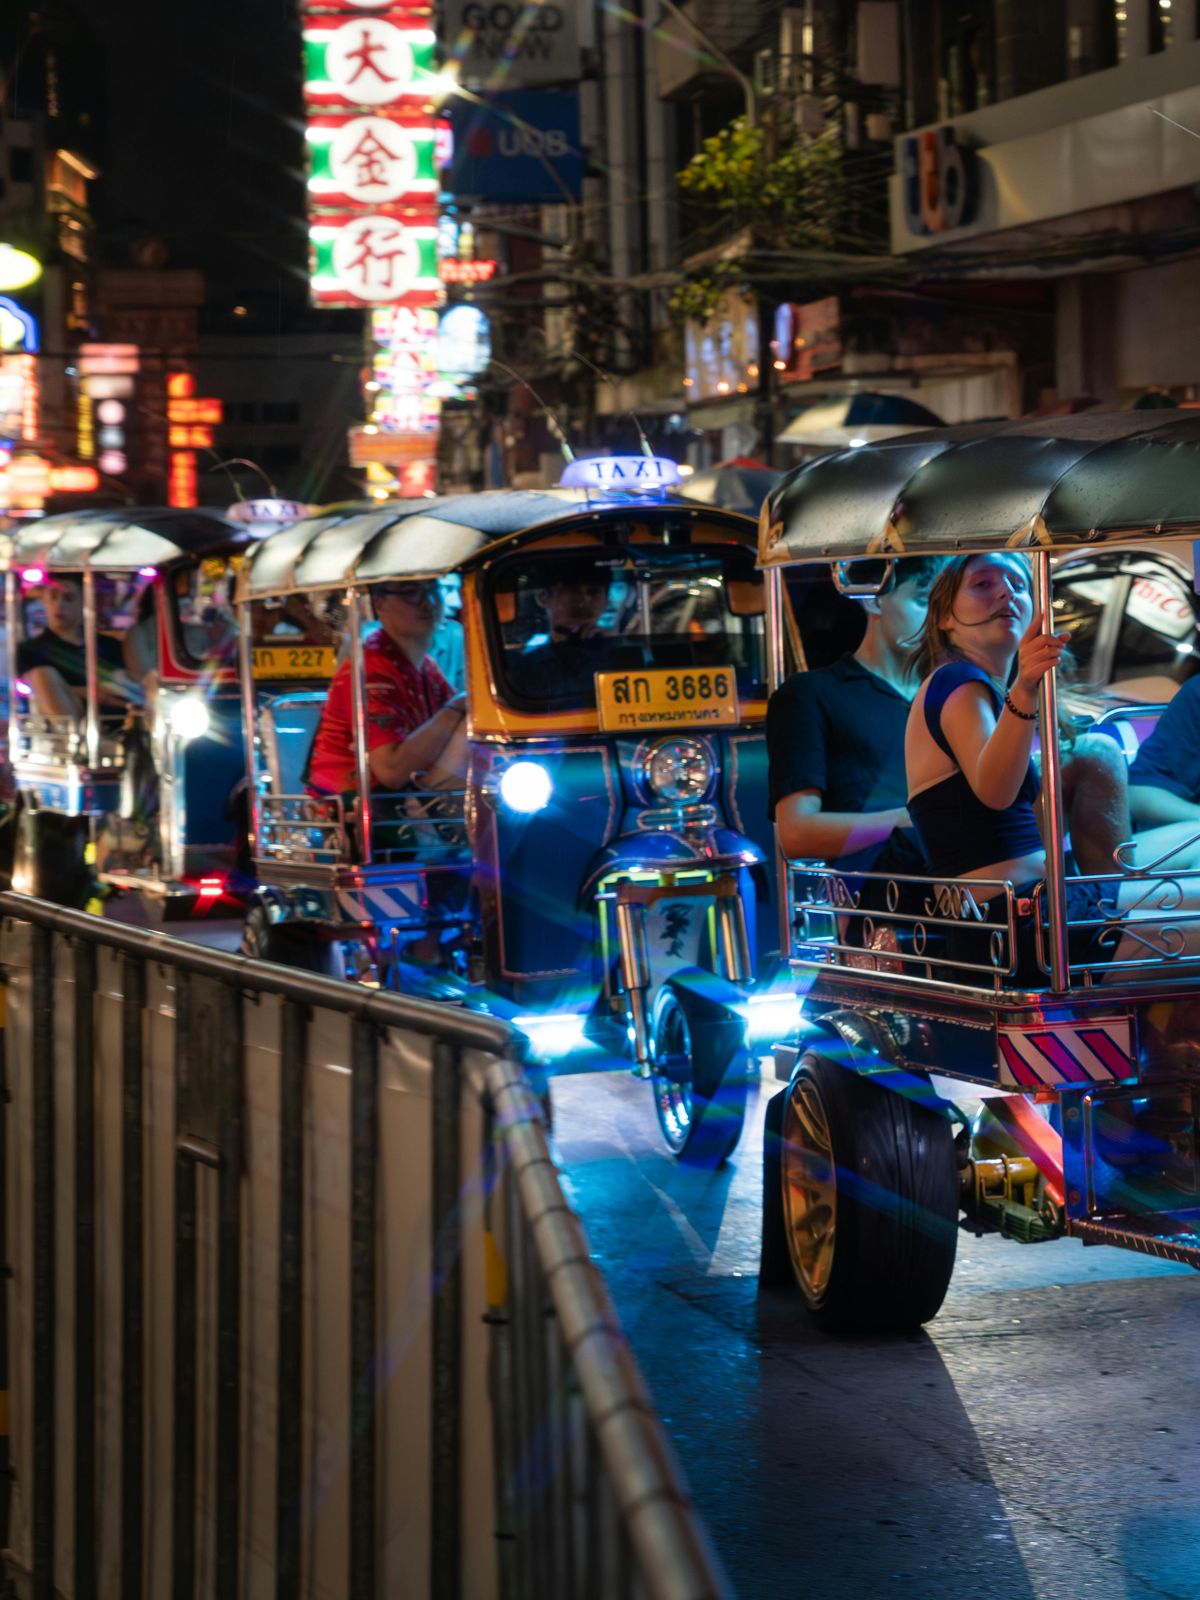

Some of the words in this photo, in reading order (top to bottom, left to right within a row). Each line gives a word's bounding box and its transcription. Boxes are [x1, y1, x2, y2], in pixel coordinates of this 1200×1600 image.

[342, 30, 407, 288] 大金行
[591, 460, 664, 478] TAXI
[248, 503, 300, 517] TAXI
[287, 648, 325, 668] 227
[612, 675, 651, 704] สก
[665, 673, 728, 701] 3686
